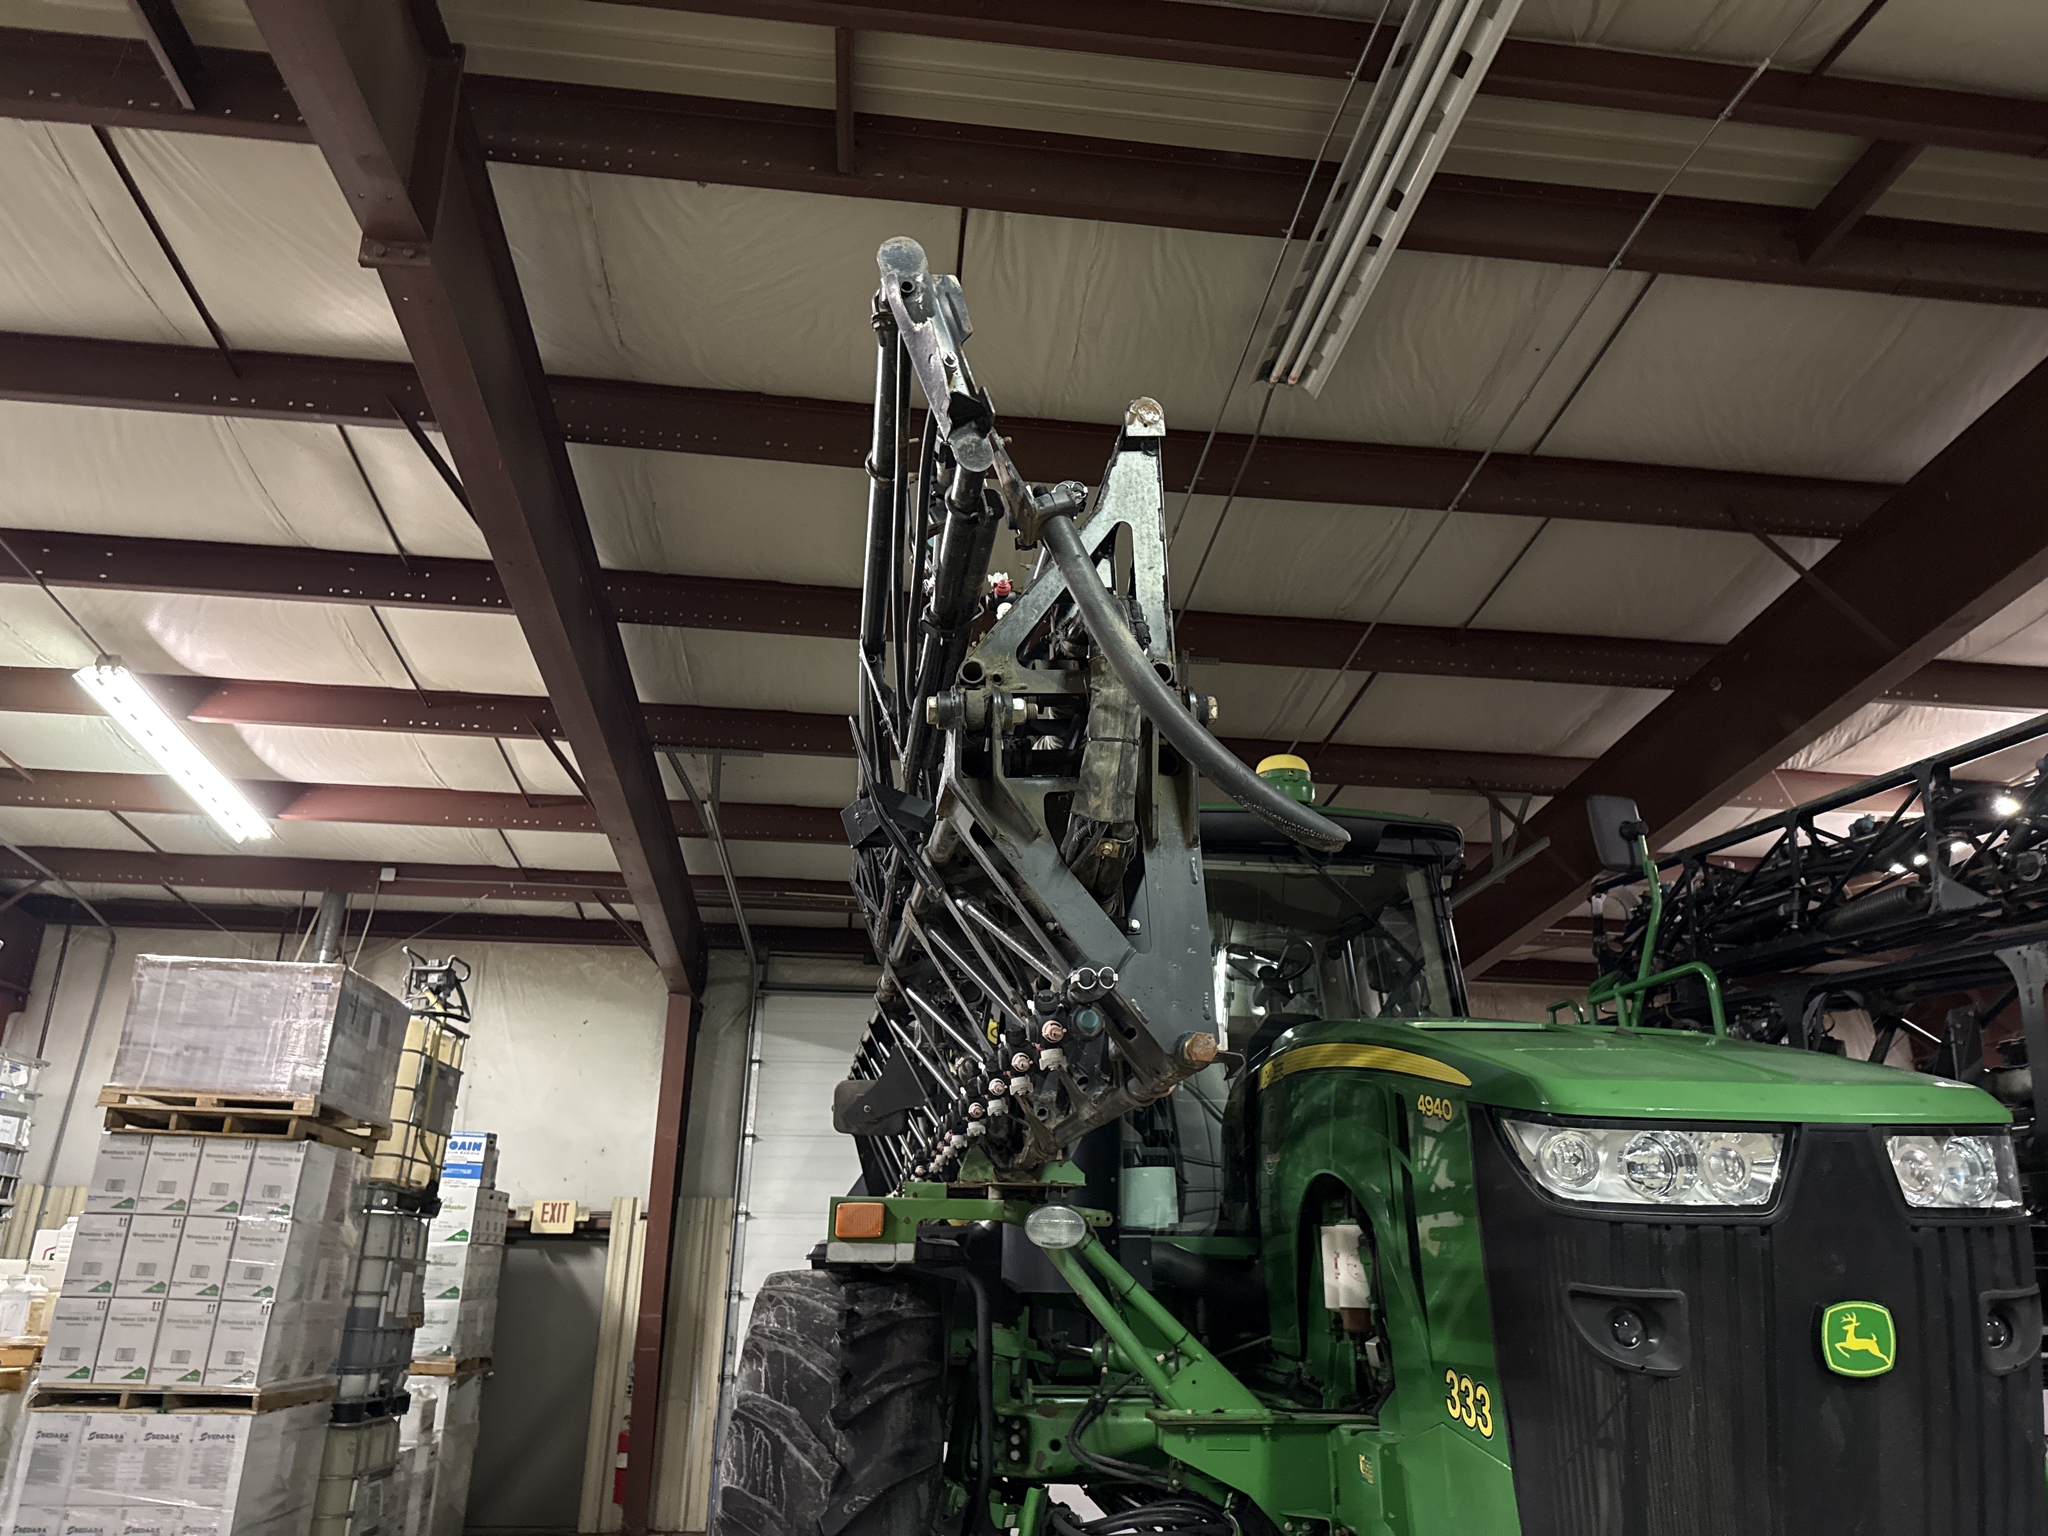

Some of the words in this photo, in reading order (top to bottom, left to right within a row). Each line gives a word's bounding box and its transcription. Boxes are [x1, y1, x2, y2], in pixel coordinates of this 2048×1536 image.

[1417, 1094, 1453, 1120] 4940
[541, 1203, 570, 1223] EXIT
[1446, 1368, 1493, 1440] 333
